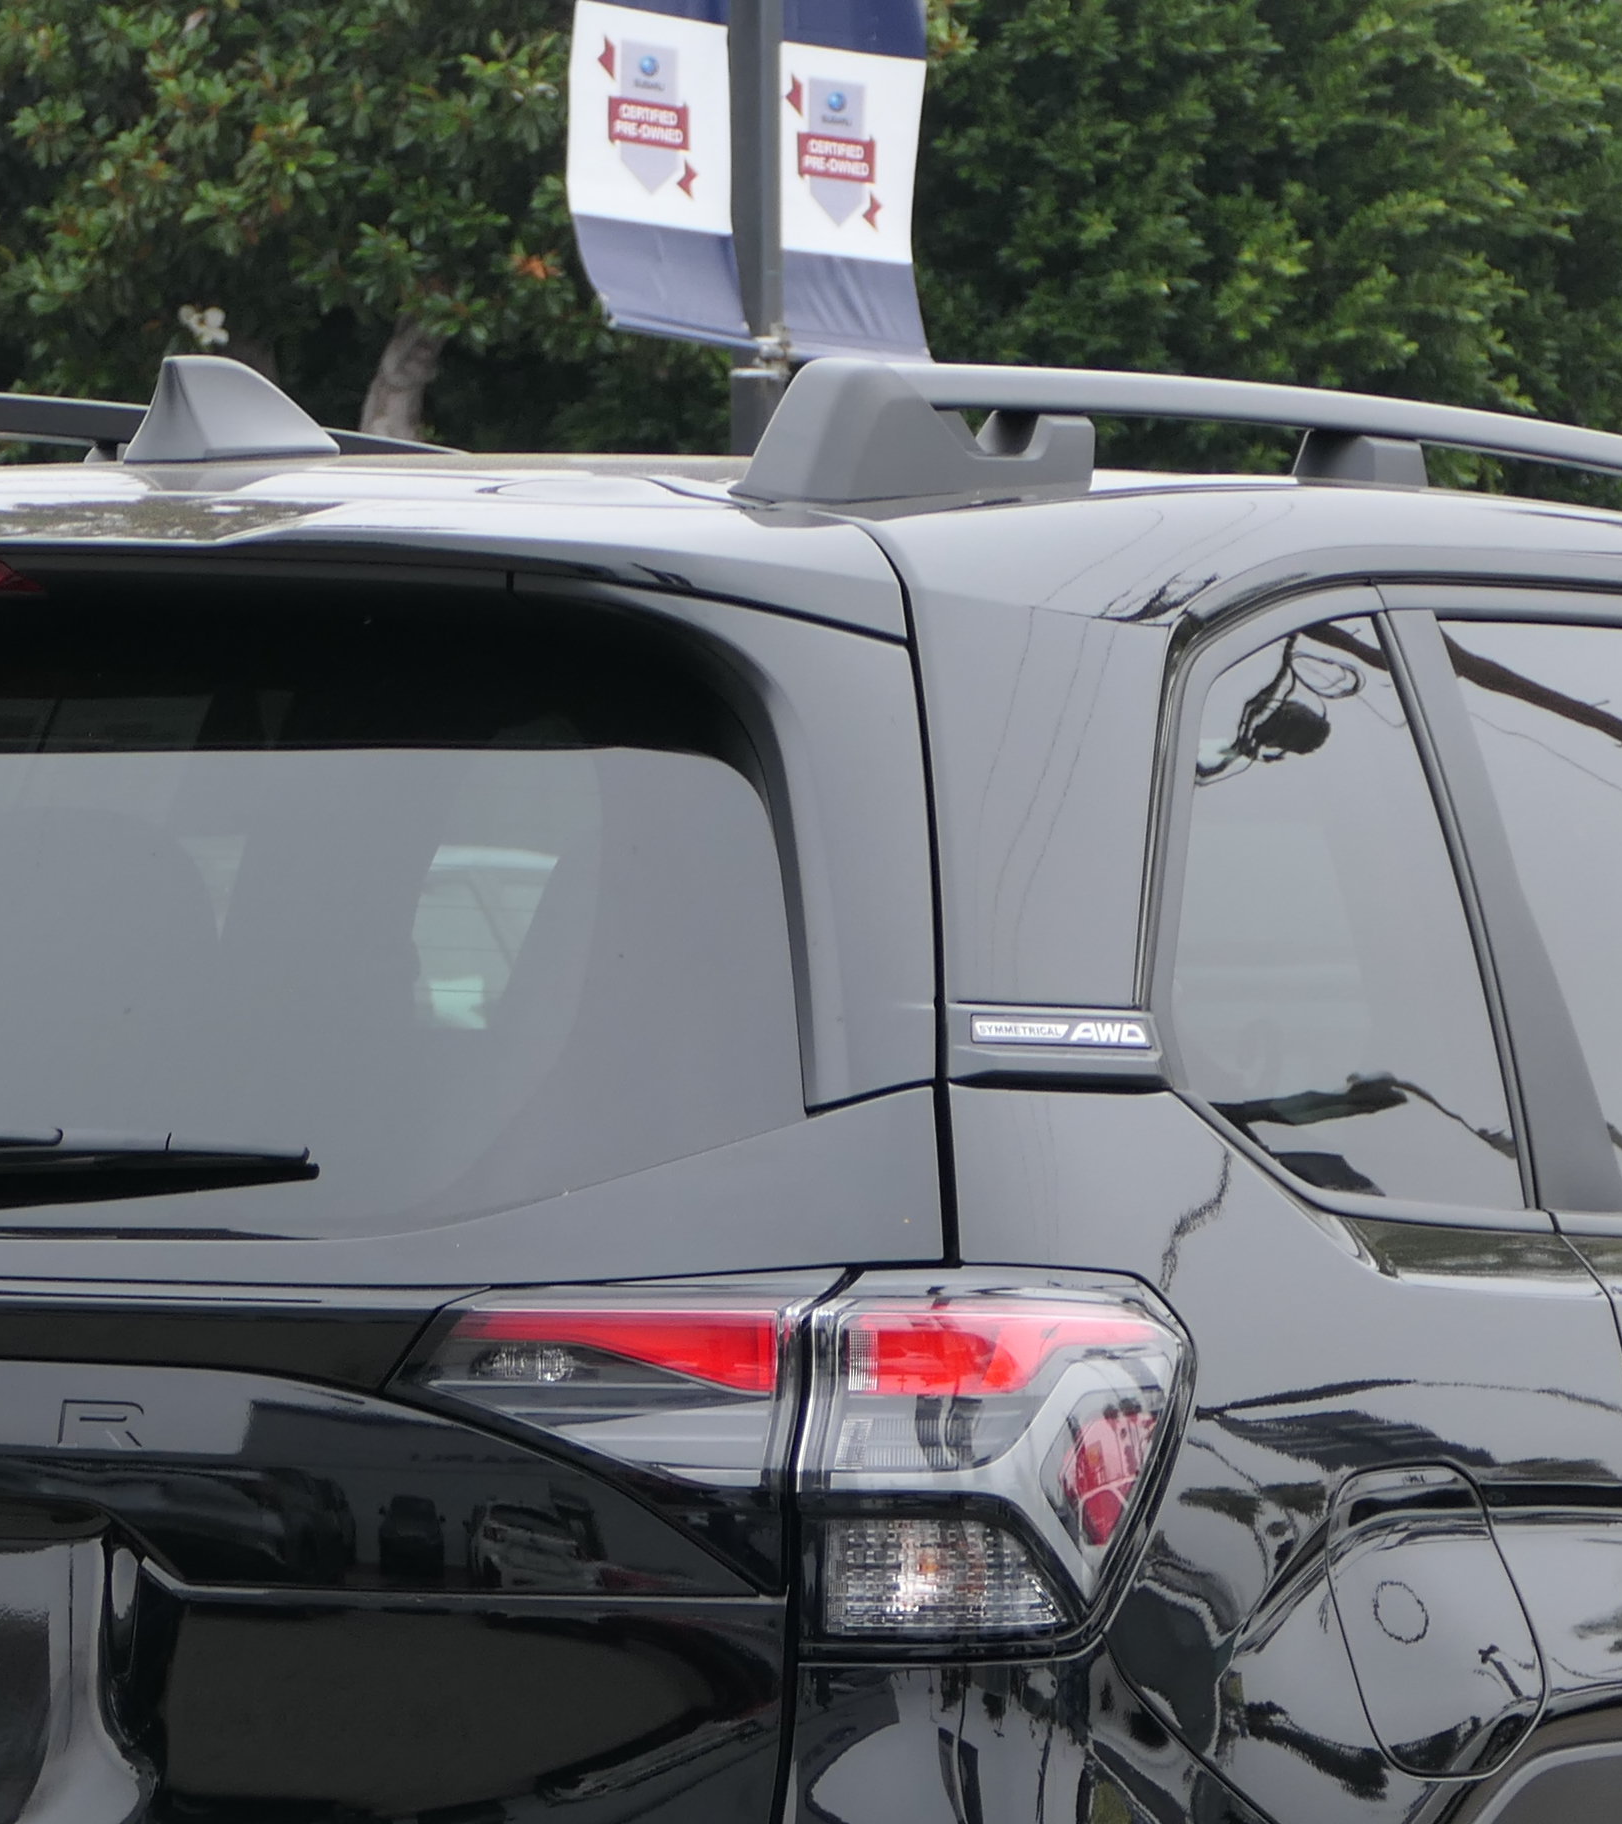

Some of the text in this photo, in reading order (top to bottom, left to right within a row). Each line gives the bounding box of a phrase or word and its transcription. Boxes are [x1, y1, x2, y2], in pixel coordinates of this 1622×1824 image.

[618, 103, 679, 127] CERTIFIED
[613, 119, 684, 145] PRE-OWNED
[806, 138, 865, 160] CERTIFIED
[802, 154, 870, 178] PRE-OWNED
[979, 1021, 1146, 1043] SYMMETRICAL AWD
